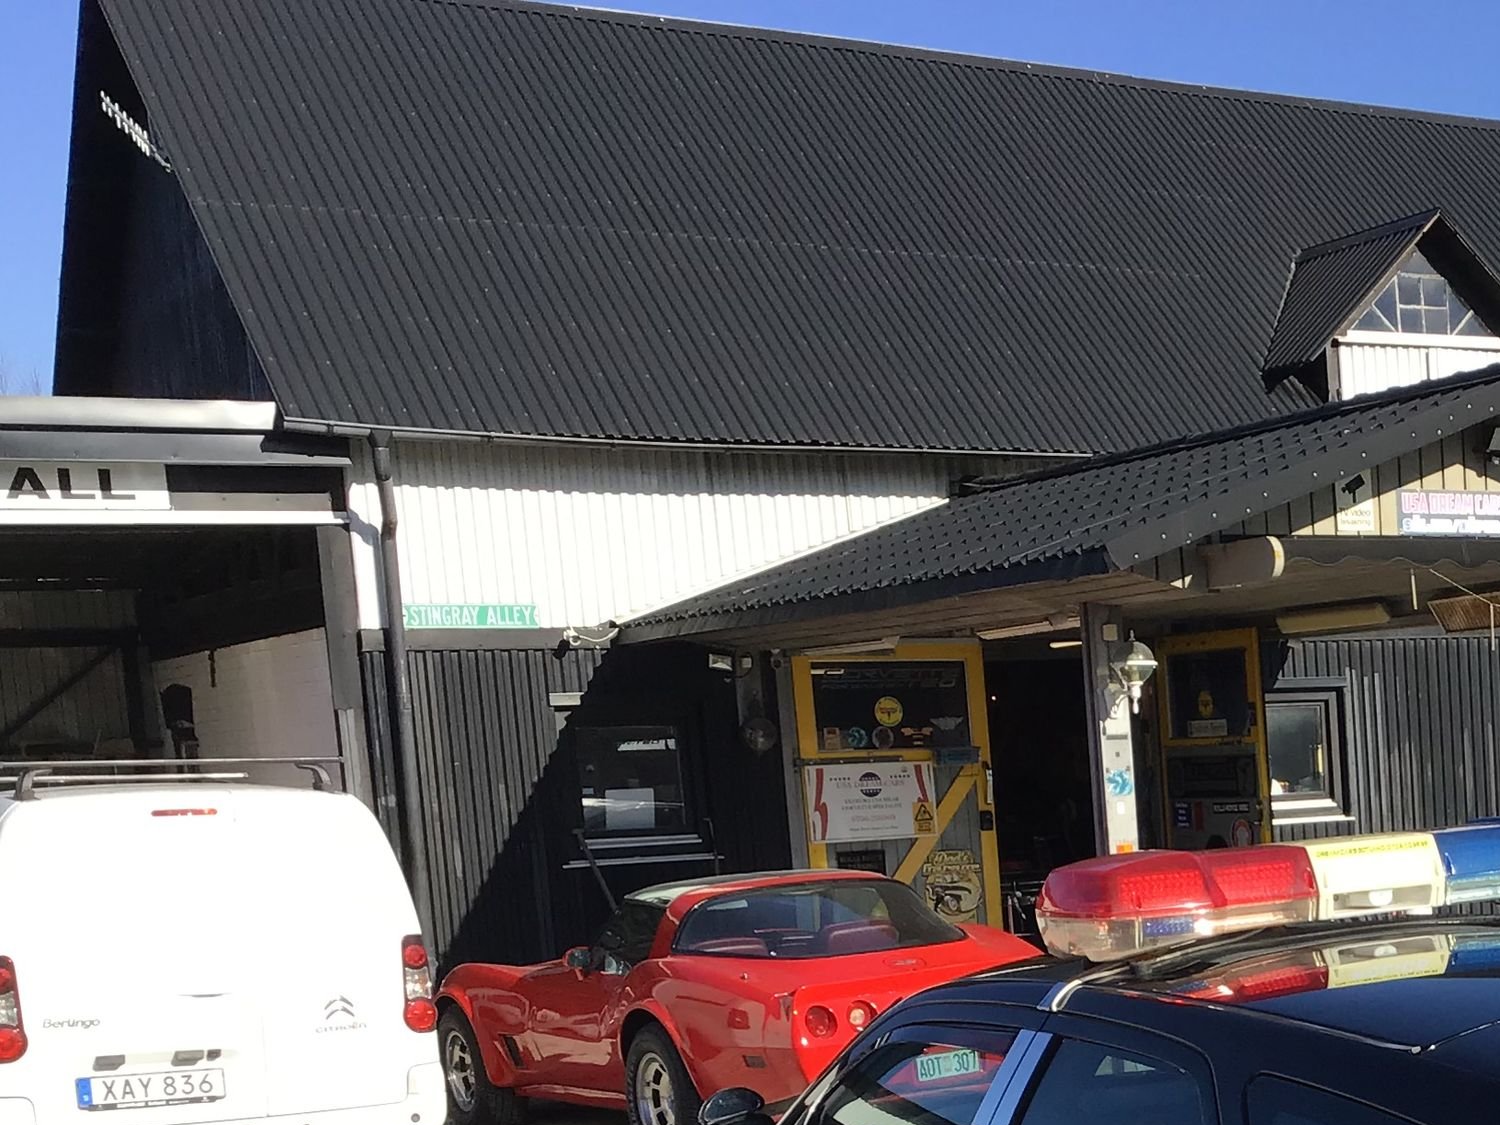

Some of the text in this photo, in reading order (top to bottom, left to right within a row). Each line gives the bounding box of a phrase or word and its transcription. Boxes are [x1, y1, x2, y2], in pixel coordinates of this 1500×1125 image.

[7, 467, 136, 500] ALL
[1401, 492, 1428, 514] USA
[1429, 492, 1474, 515] DREAM
[410, 606, 531, 625] STINGRAY ALLEY
[42, 1018, 100, 1029] Berlingo
[953, 1051, 976, 1072] 307
[101, 1073, 213, 1101] XAY 836
